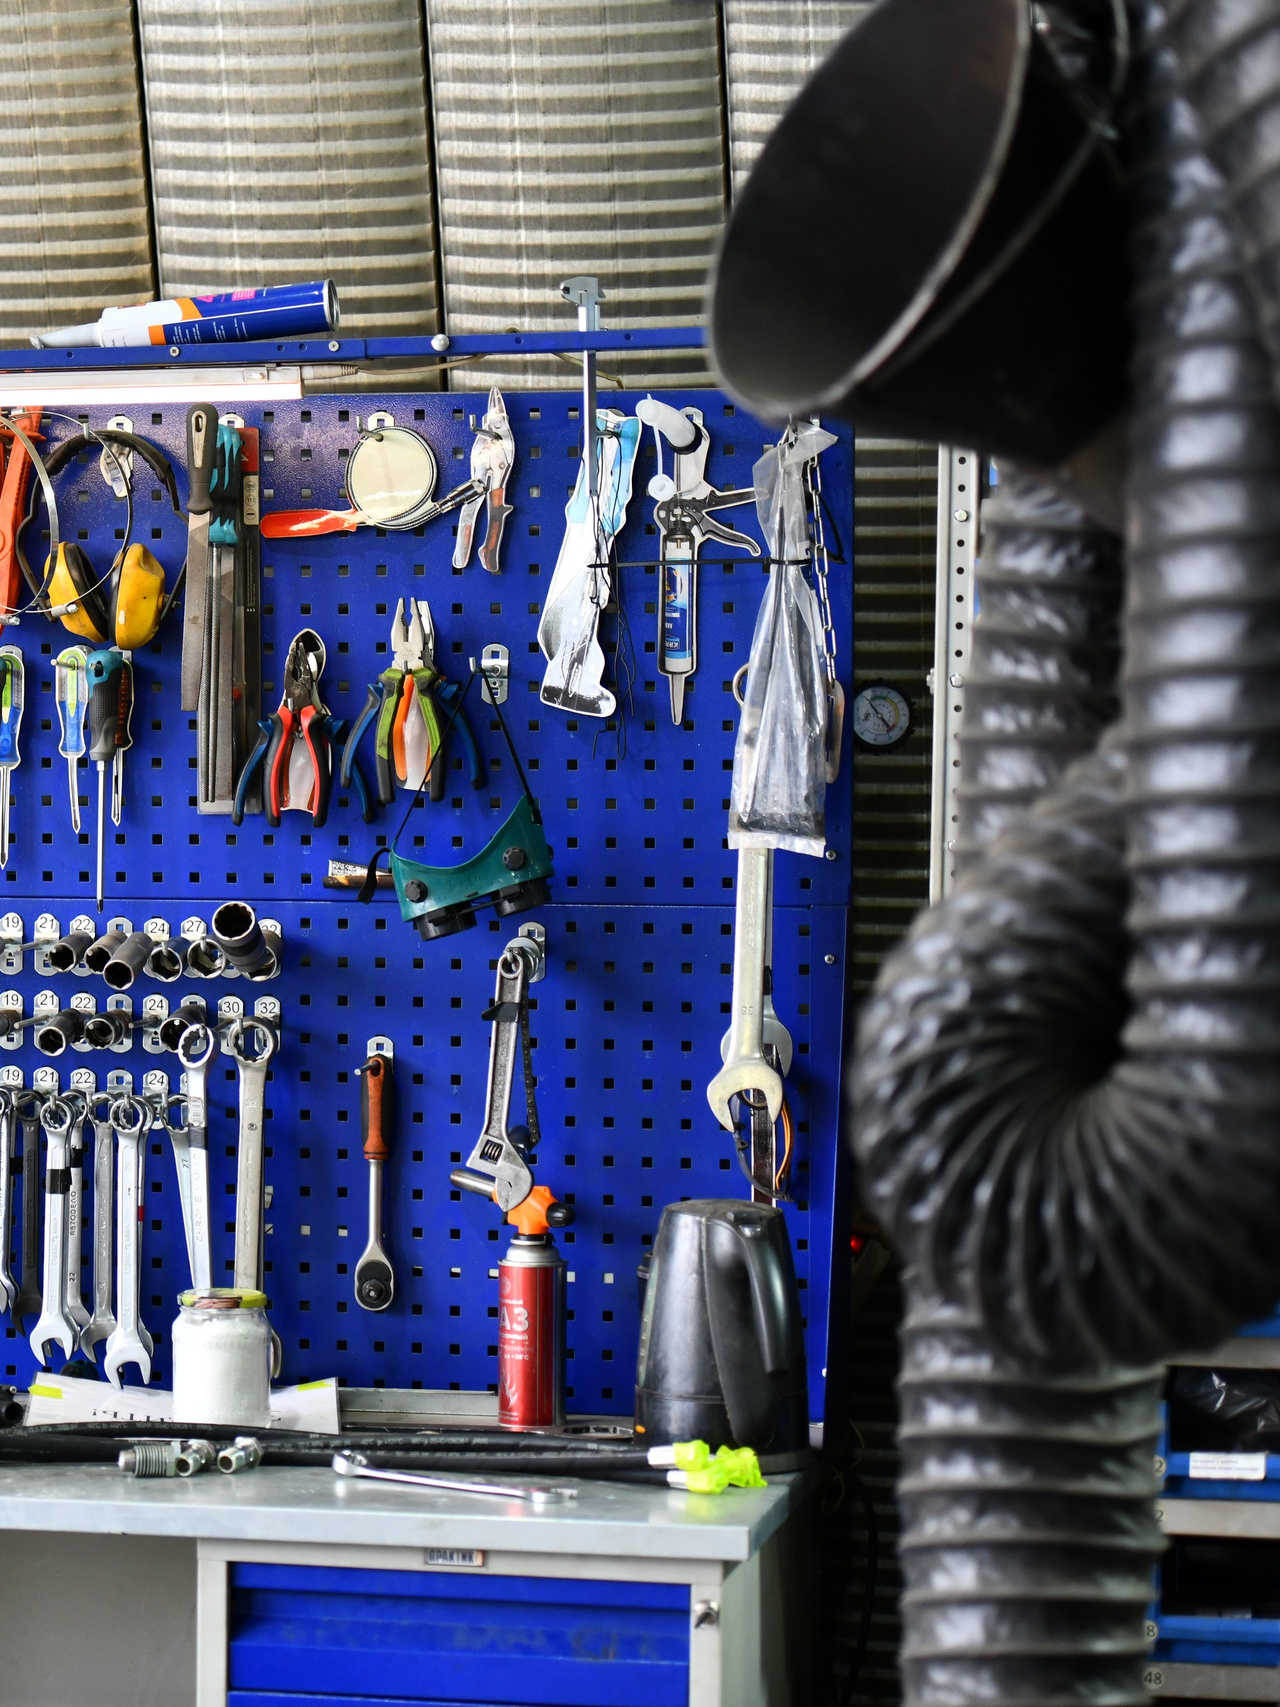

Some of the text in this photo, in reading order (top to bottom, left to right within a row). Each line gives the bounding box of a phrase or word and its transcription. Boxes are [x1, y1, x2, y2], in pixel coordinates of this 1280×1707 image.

[6, 917, 19, 927] 19
[40, 917, 53, 928] 21
[76, 919, 90, 931] 22
[151, 922, 165, 933] 24
[187, 919, 202, 932] 27
[5, 994, 18, 1005] 19
[41, 994, 53, 1005] 21
[75, 997, 90, 1008] 22
[149, 999, 163, 1010] 24
[224, 1002, 239, 1013] 30
[261, 1002, 276, 1013] 32
[741, 1005, 754, 1016] 36
[6, 1069, 19, 1080] 19
[40, 1071, 54, 1082] 21
[76, 1072, 91, 1083] 22
[149, 1074, 164, 1085] 24
[245, 1098, 257, 1108] 32
[182, 1158, 189, 1169] 27
[194, 1196, 204, 1242] CHROME
[69, 1191, 77, 1282] 22 АВТОДЕЛО
[500, 1306, 530, 1332] АЗ
[427, 1549, 476, 1564] ПРАКТИК
[1143, 1672, 1162, 1685] 48
